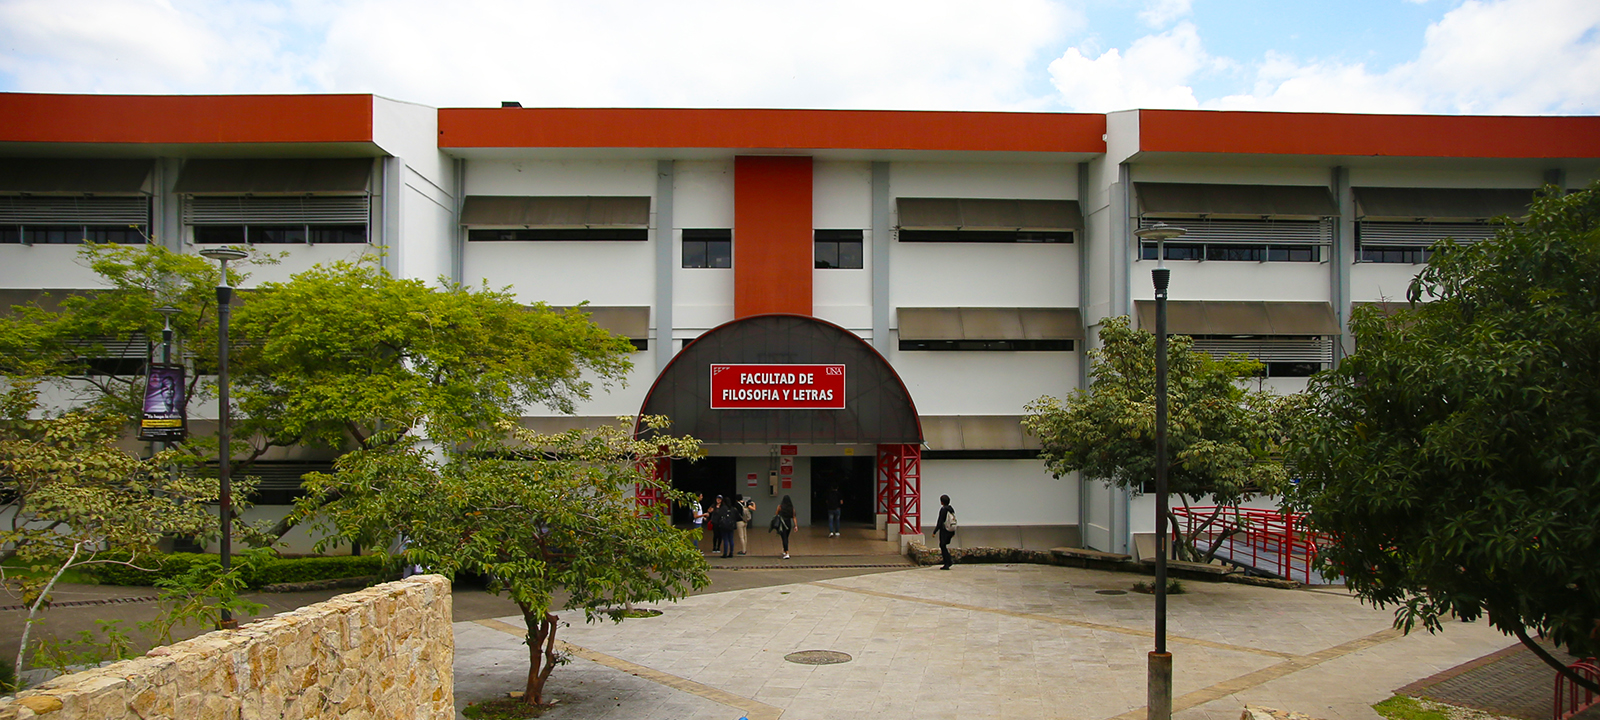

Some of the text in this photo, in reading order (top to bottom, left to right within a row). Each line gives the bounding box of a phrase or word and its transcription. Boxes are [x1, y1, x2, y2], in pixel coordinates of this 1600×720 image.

[825, 366, 843, 375] UNA
[740, 373, 814, 385] FACULTAD DE
[722, 389, 834, 401] FILOSOFIA Y LETRAS
